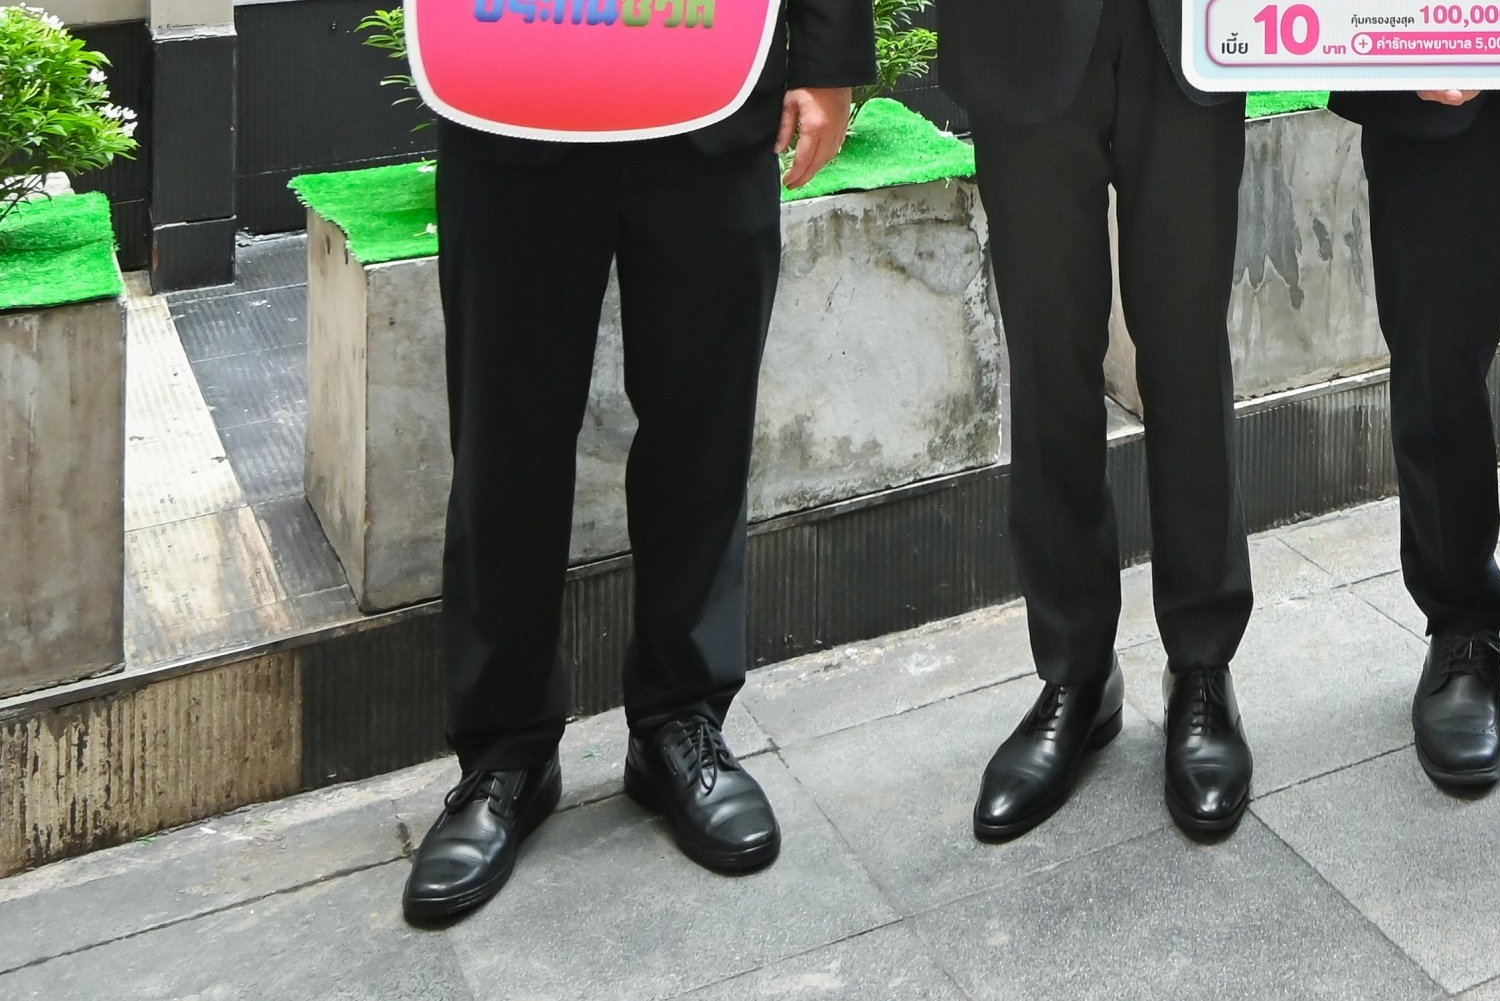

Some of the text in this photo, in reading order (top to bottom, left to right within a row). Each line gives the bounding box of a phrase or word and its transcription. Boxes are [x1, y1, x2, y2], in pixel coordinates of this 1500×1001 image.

[1351, 13, 1415, 28] คุ้มครองสูงสุด
[1221, 4, 1347, 56] เบี้ย 10 บาท
[1376, 35, 1472, 51] ค่ารักษาพยาบาล
